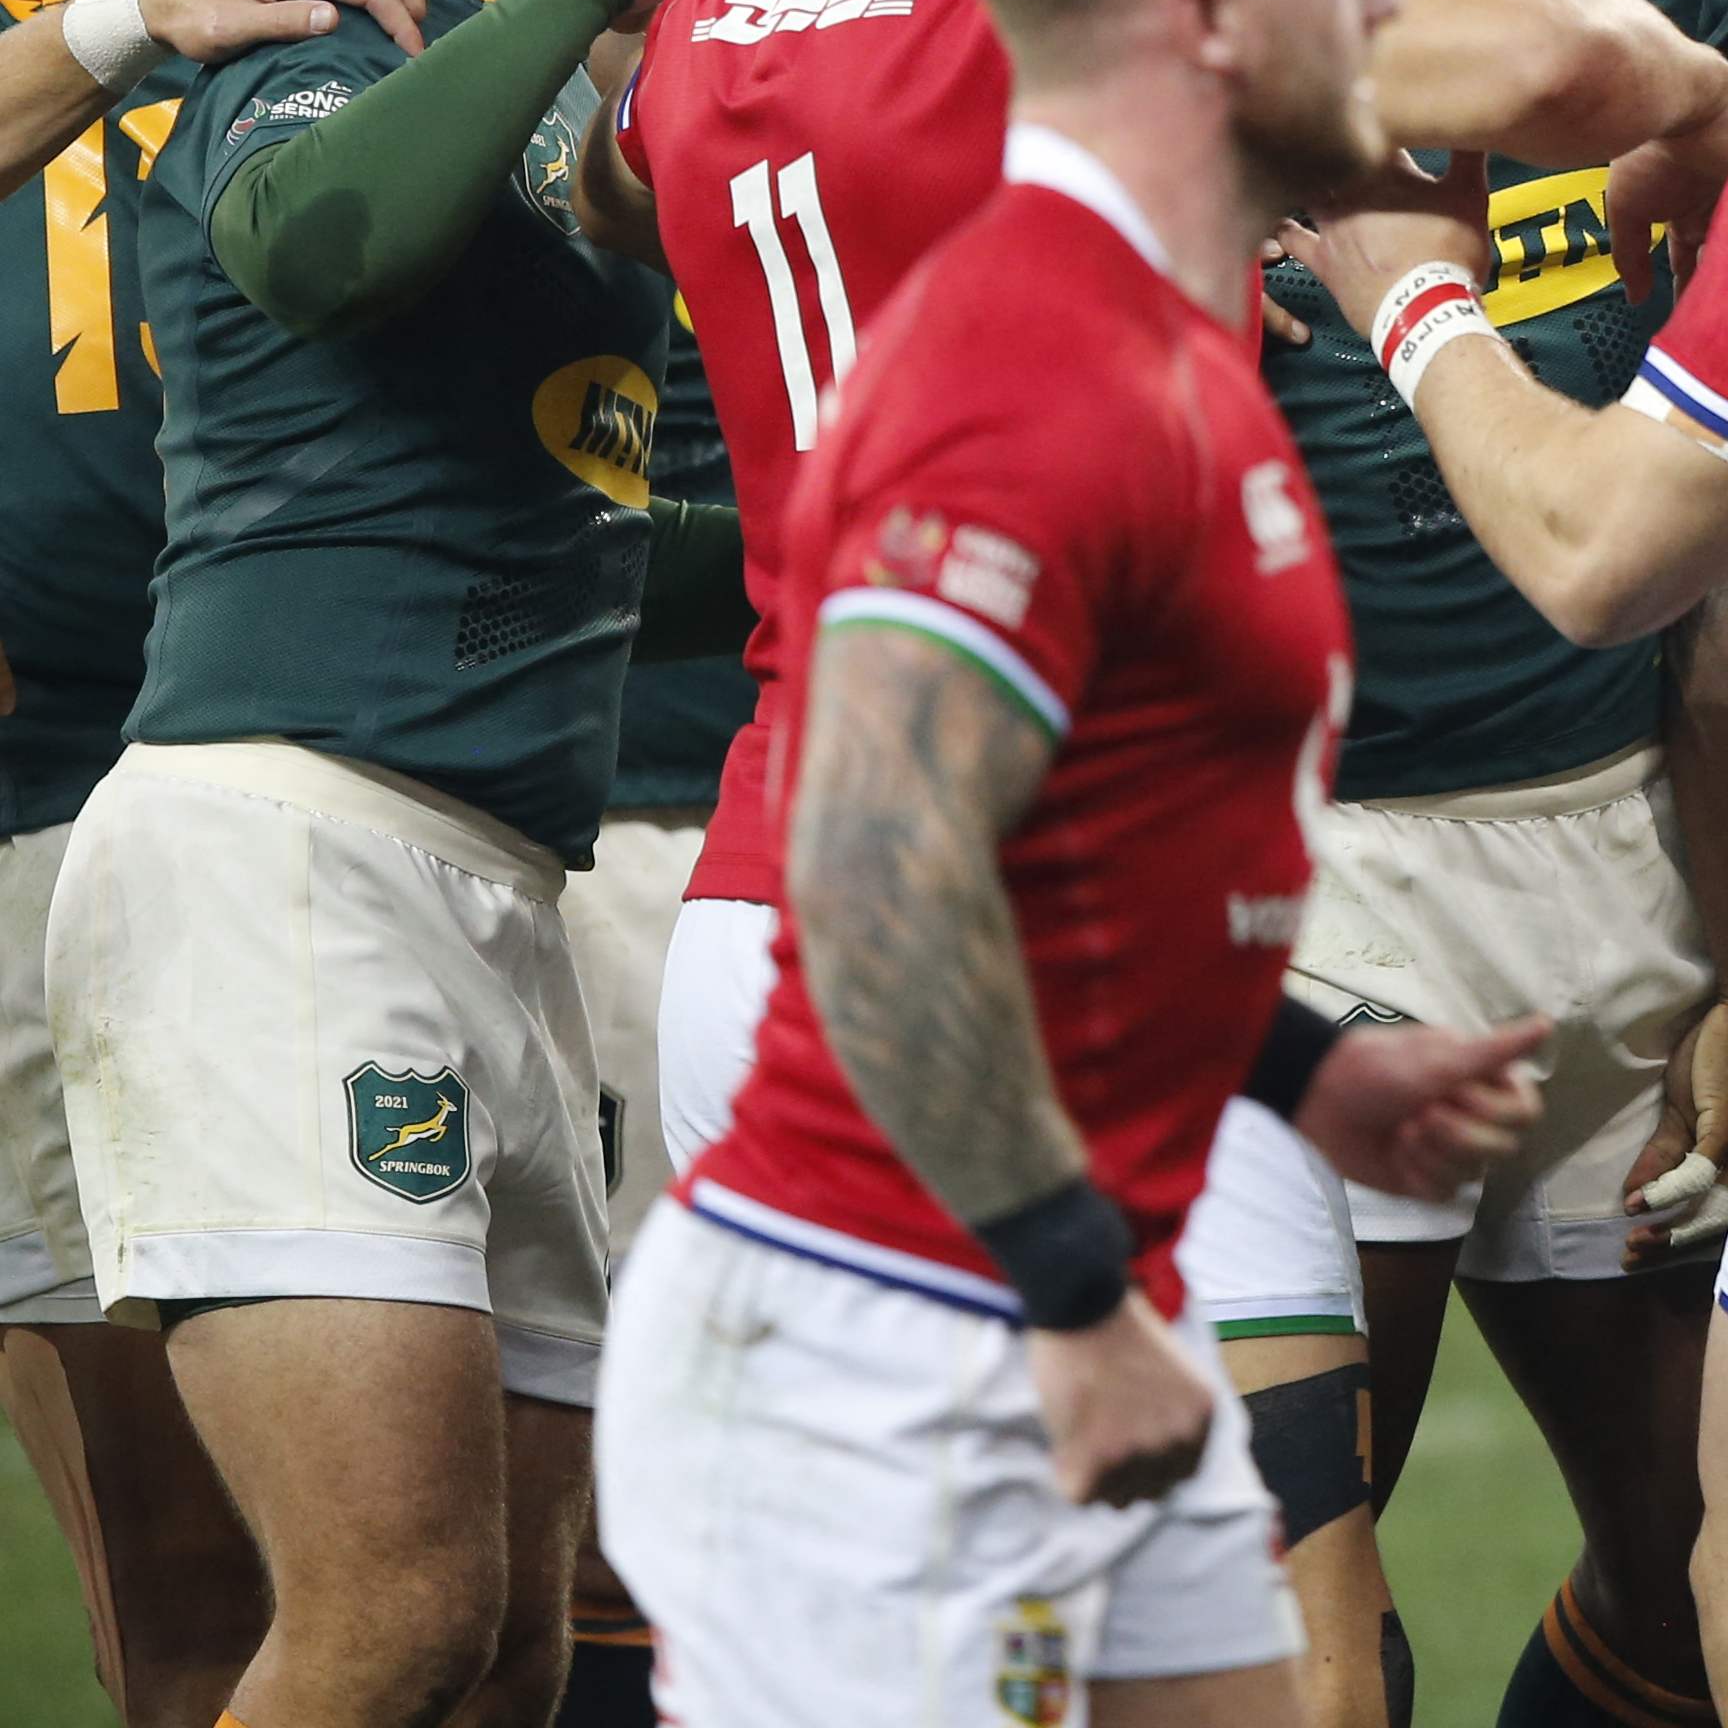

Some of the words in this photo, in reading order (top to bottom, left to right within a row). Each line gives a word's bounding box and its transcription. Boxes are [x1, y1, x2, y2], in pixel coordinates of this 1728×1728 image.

[282, 90, 350, 113] ONS
[729, 151, 858, 452] 11
[568, 379, 655, 481] MTN
[375, 1094, 409, 1110] 2021
[379, 1159, 451, 1177] SPRINGBOK
